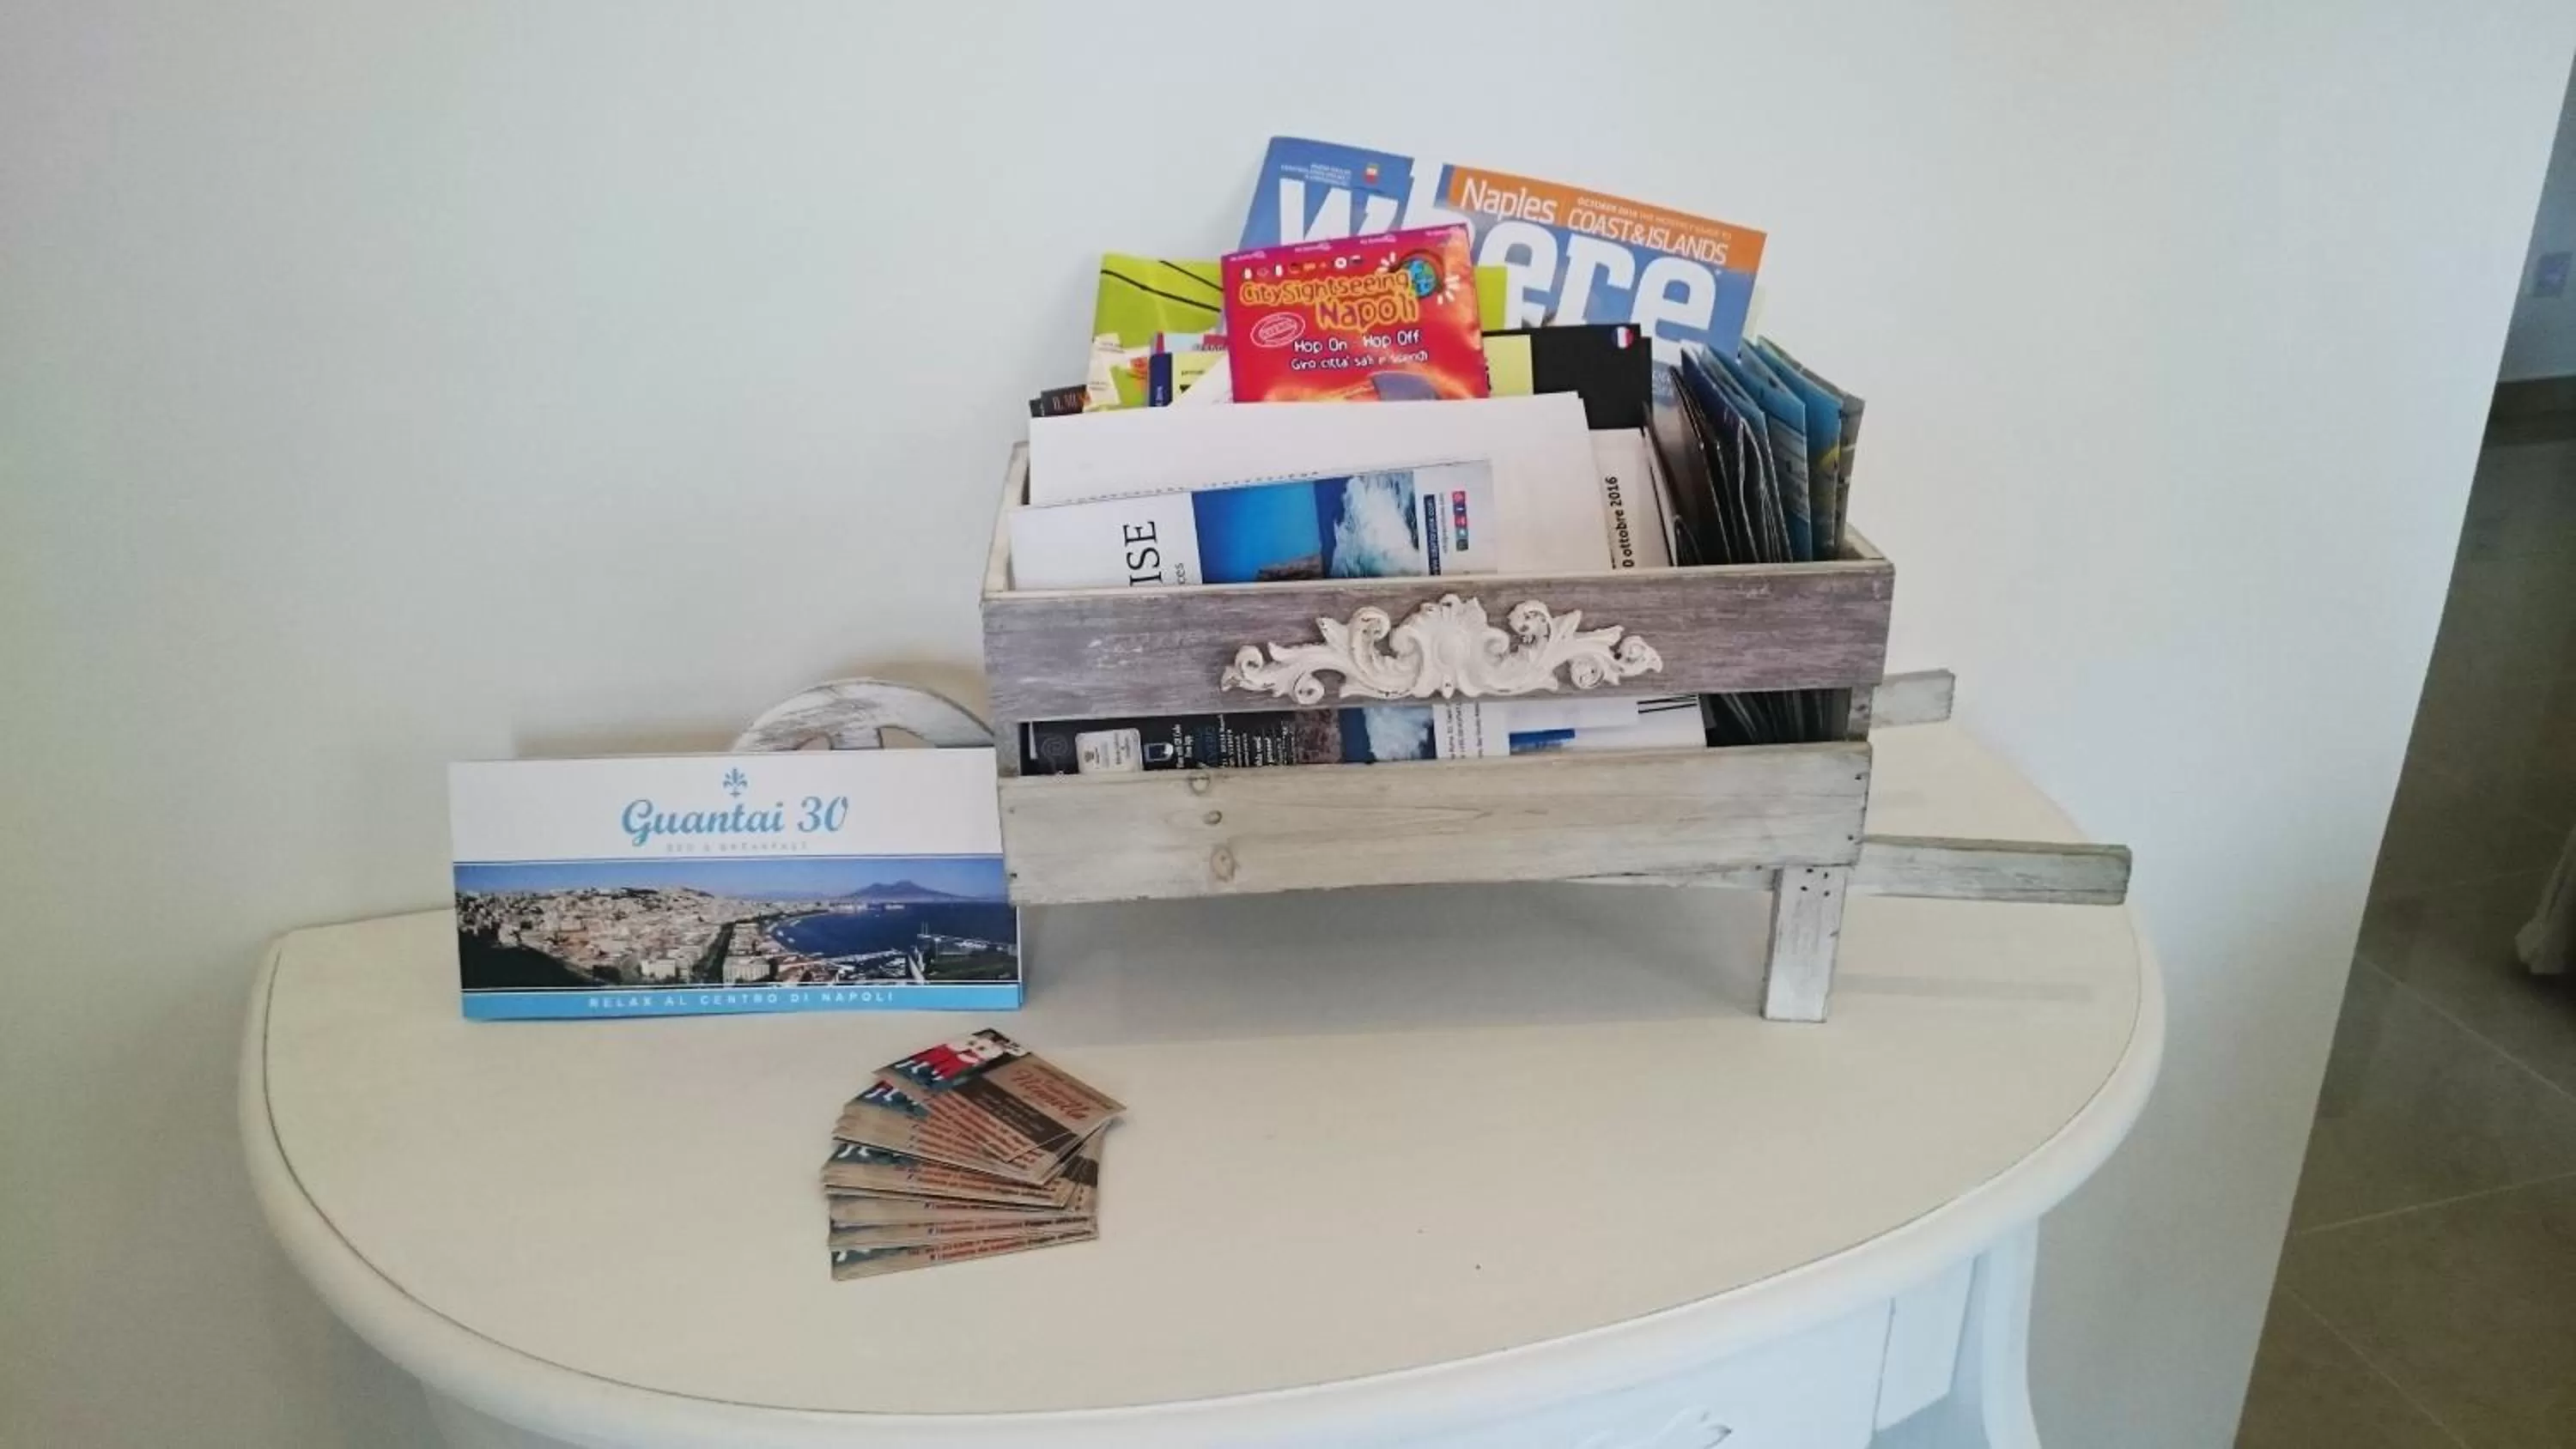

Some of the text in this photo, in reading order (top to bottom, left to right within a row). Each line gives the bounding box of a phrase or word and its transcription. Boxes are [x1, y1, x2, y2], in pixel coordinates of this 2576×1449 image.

[1460, 177, 1558, 224] Naples
[1240, 270, 1411, 306] CitySightseeing
[1318, 294, 1418, 330] Napoli
[1294, 329, 1421, 354] Hop On Hop Off
[1291, 358, 1316, 371] Giro
[1604, 476, 1623, 507] 2016
[1613, 509, 1633, 557] ottobre
[1122, 520, 1164, 587] ISE
[621, 796, 849, 847] Guantai 30
[588, 991, 894, 1009] RELAX AL CENTRO DI NAPOLI
